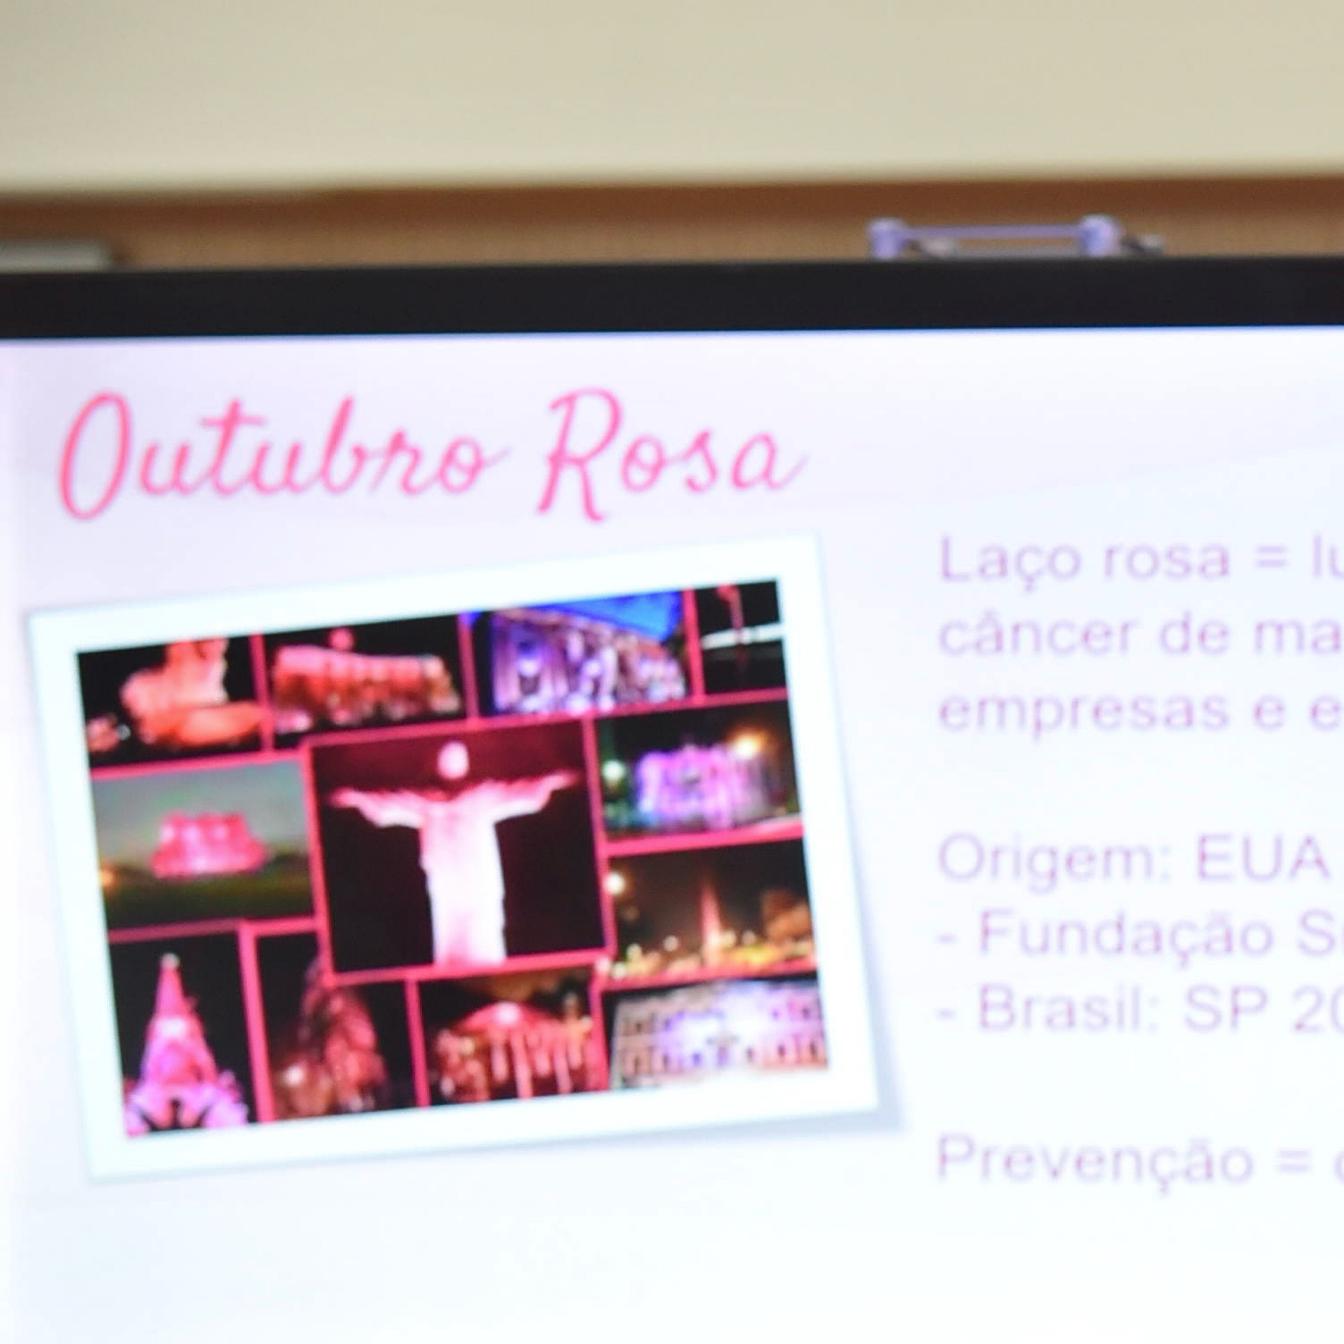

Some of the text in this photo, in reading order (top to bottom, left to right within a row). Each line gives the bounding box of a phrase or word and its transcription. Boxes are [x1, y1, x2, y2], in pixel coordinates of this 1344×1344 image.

[56, 386, 808, 524] Outubro Rosa
[938, 533, 1083, 594] Laço
[1103, 542, 1232, 582] rosa
[1255, 543, 1288, 570] =
[937, 609, 1137, 658] câncer
[1157, 609, 1231, 657] de
[936, 693, 1231, 743] empresas
[1250, 693, 1287, 733] e
[936, 832, 1172, 895] Origem:
[1195, 832, 1333, 884] EUA
[978, 907, 1276, 967] Fundação
[977, 981, 1159, 1034] Brasil:
[1183, 983, 1270, 1035] SP
[936, 1132, 1255, 1197] Prevenção
[1277, 1148, 1312, 1175] =
